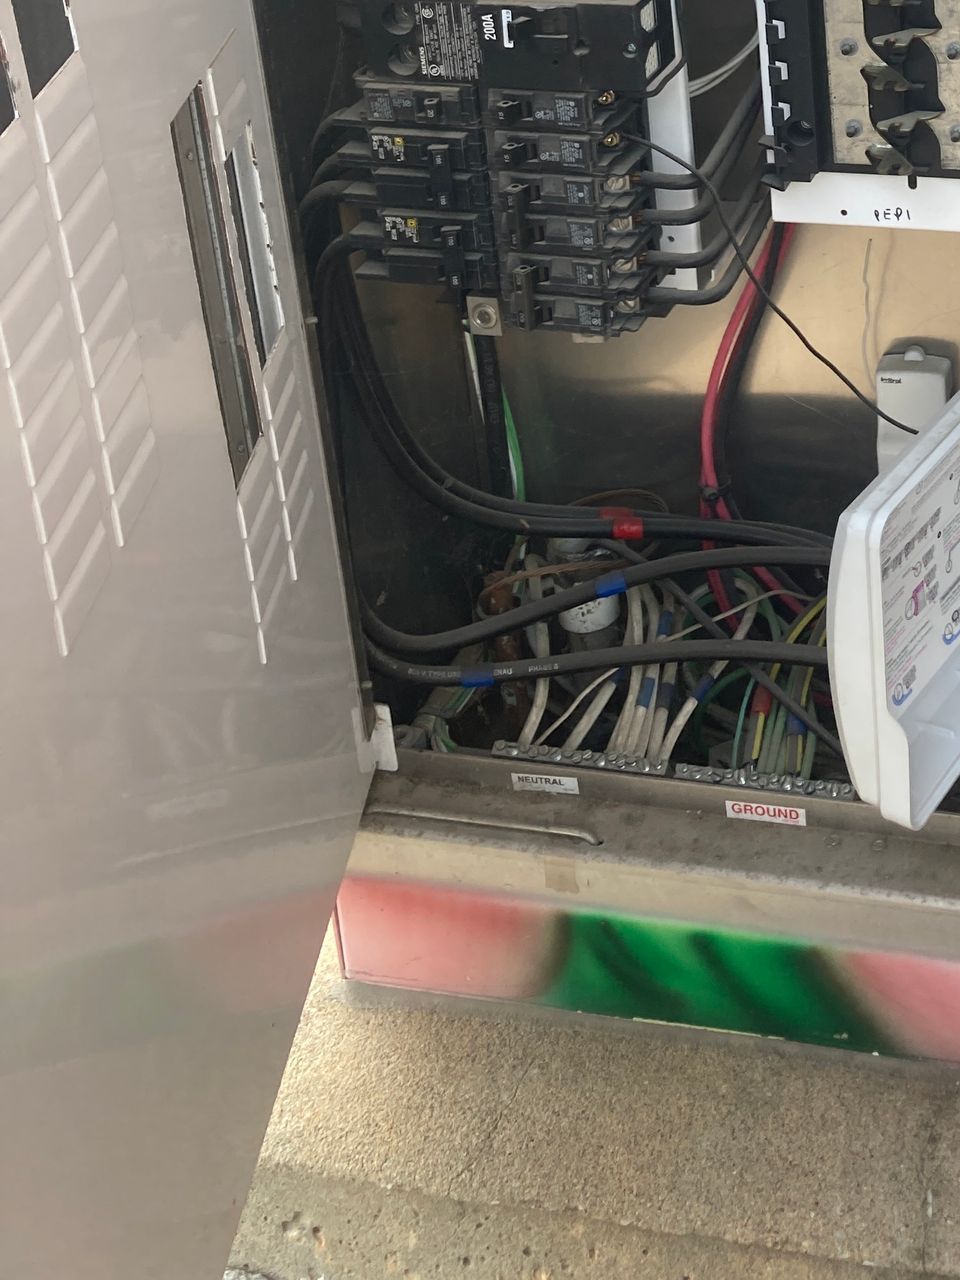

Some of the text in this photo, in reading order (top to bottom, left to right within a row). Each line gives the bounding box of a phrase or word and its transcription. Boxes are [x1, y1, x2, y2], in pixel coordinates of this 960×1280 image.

[481, 13, 497, 40] 200A
[419, 46, 427, 75] SIEMENS
[517, 775, 564, 786] NEUTRAL
[731, 803, 800, 820] GROUND
